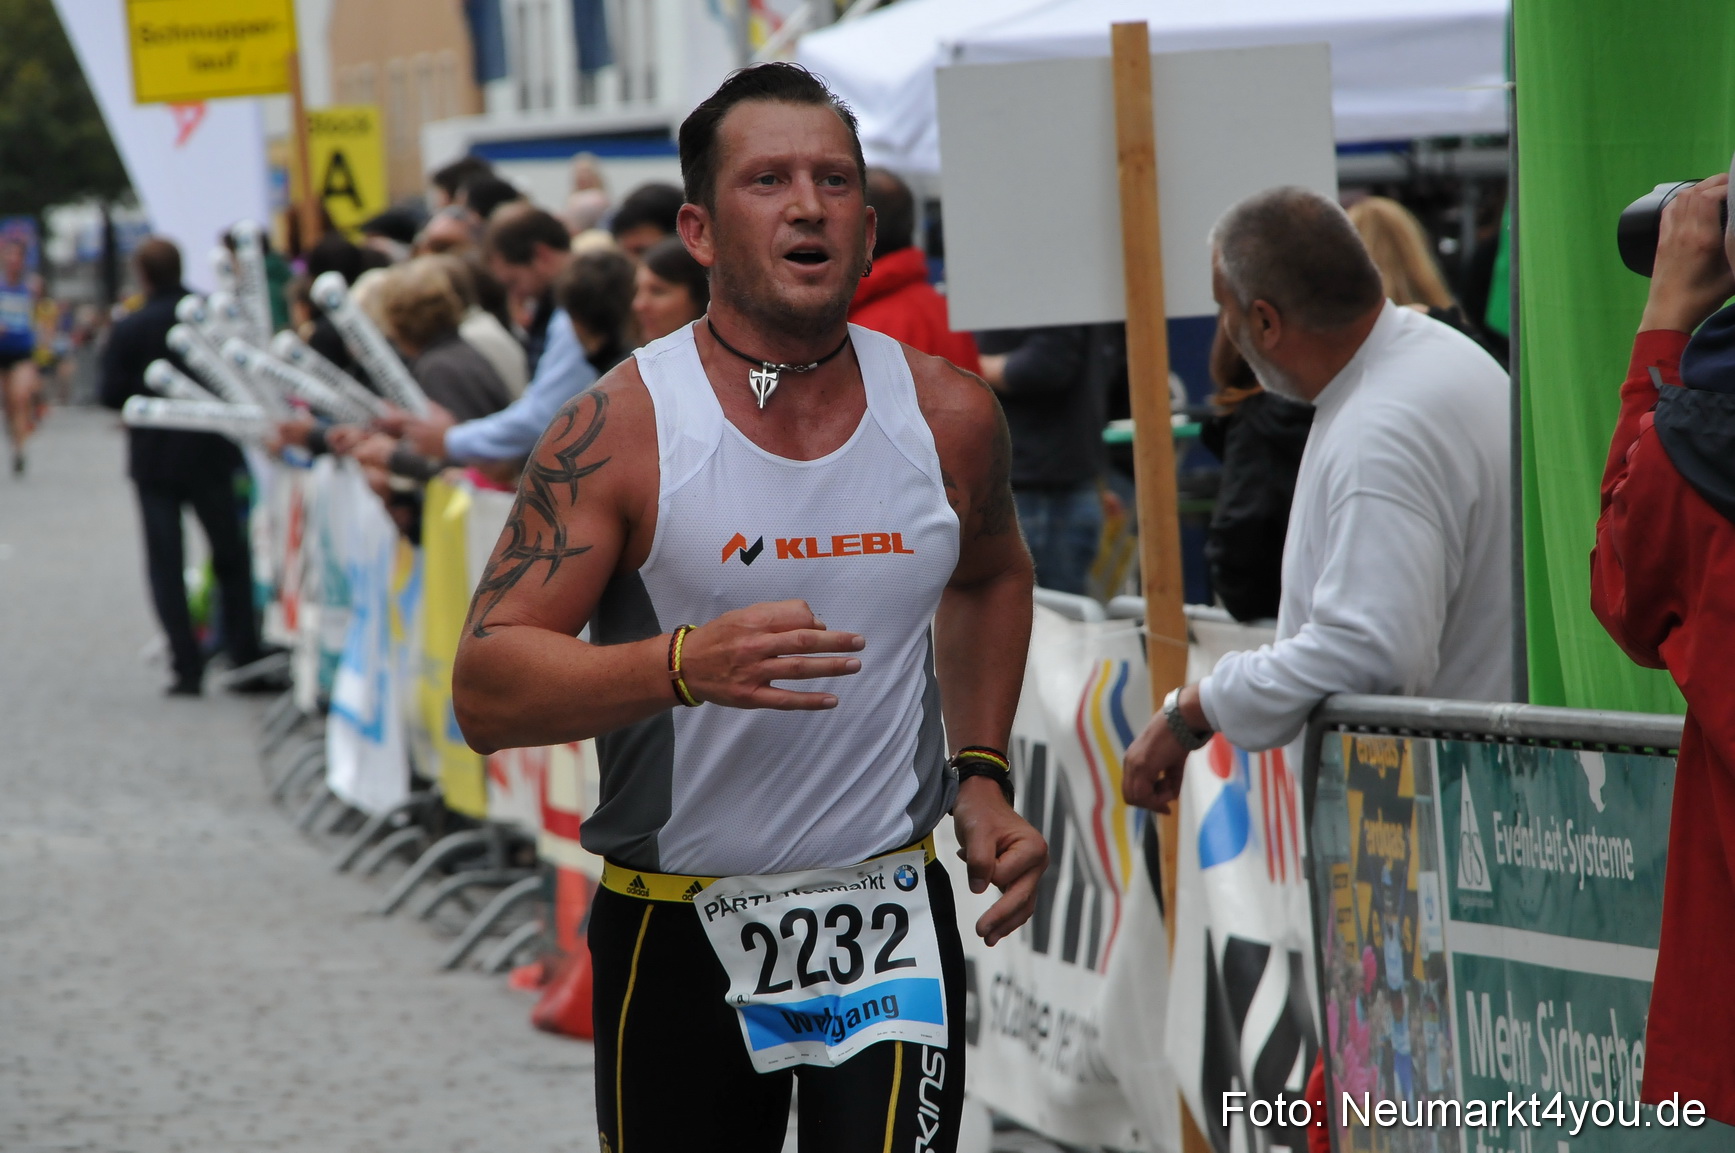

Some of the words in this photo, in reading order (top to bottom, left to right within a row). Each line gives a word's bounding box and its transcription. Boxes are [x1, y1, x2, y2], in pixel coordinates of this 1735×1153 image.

[190, 49, 240, 73] lauf
[321, 150, 364, 209] A
[775, 532, 914, 559] KLEBL
[1493, 811, 1634, 891] Event-Leit-Systeme
[626, 886, 650, 898] adidas
[740, 902, 917, 996] 2232
[781, 994, 899, 1042] Wolgang
[1466, 990, 1532, 1086] Mehr
[1536, 1000, 1653, 1110] Sicherhe
